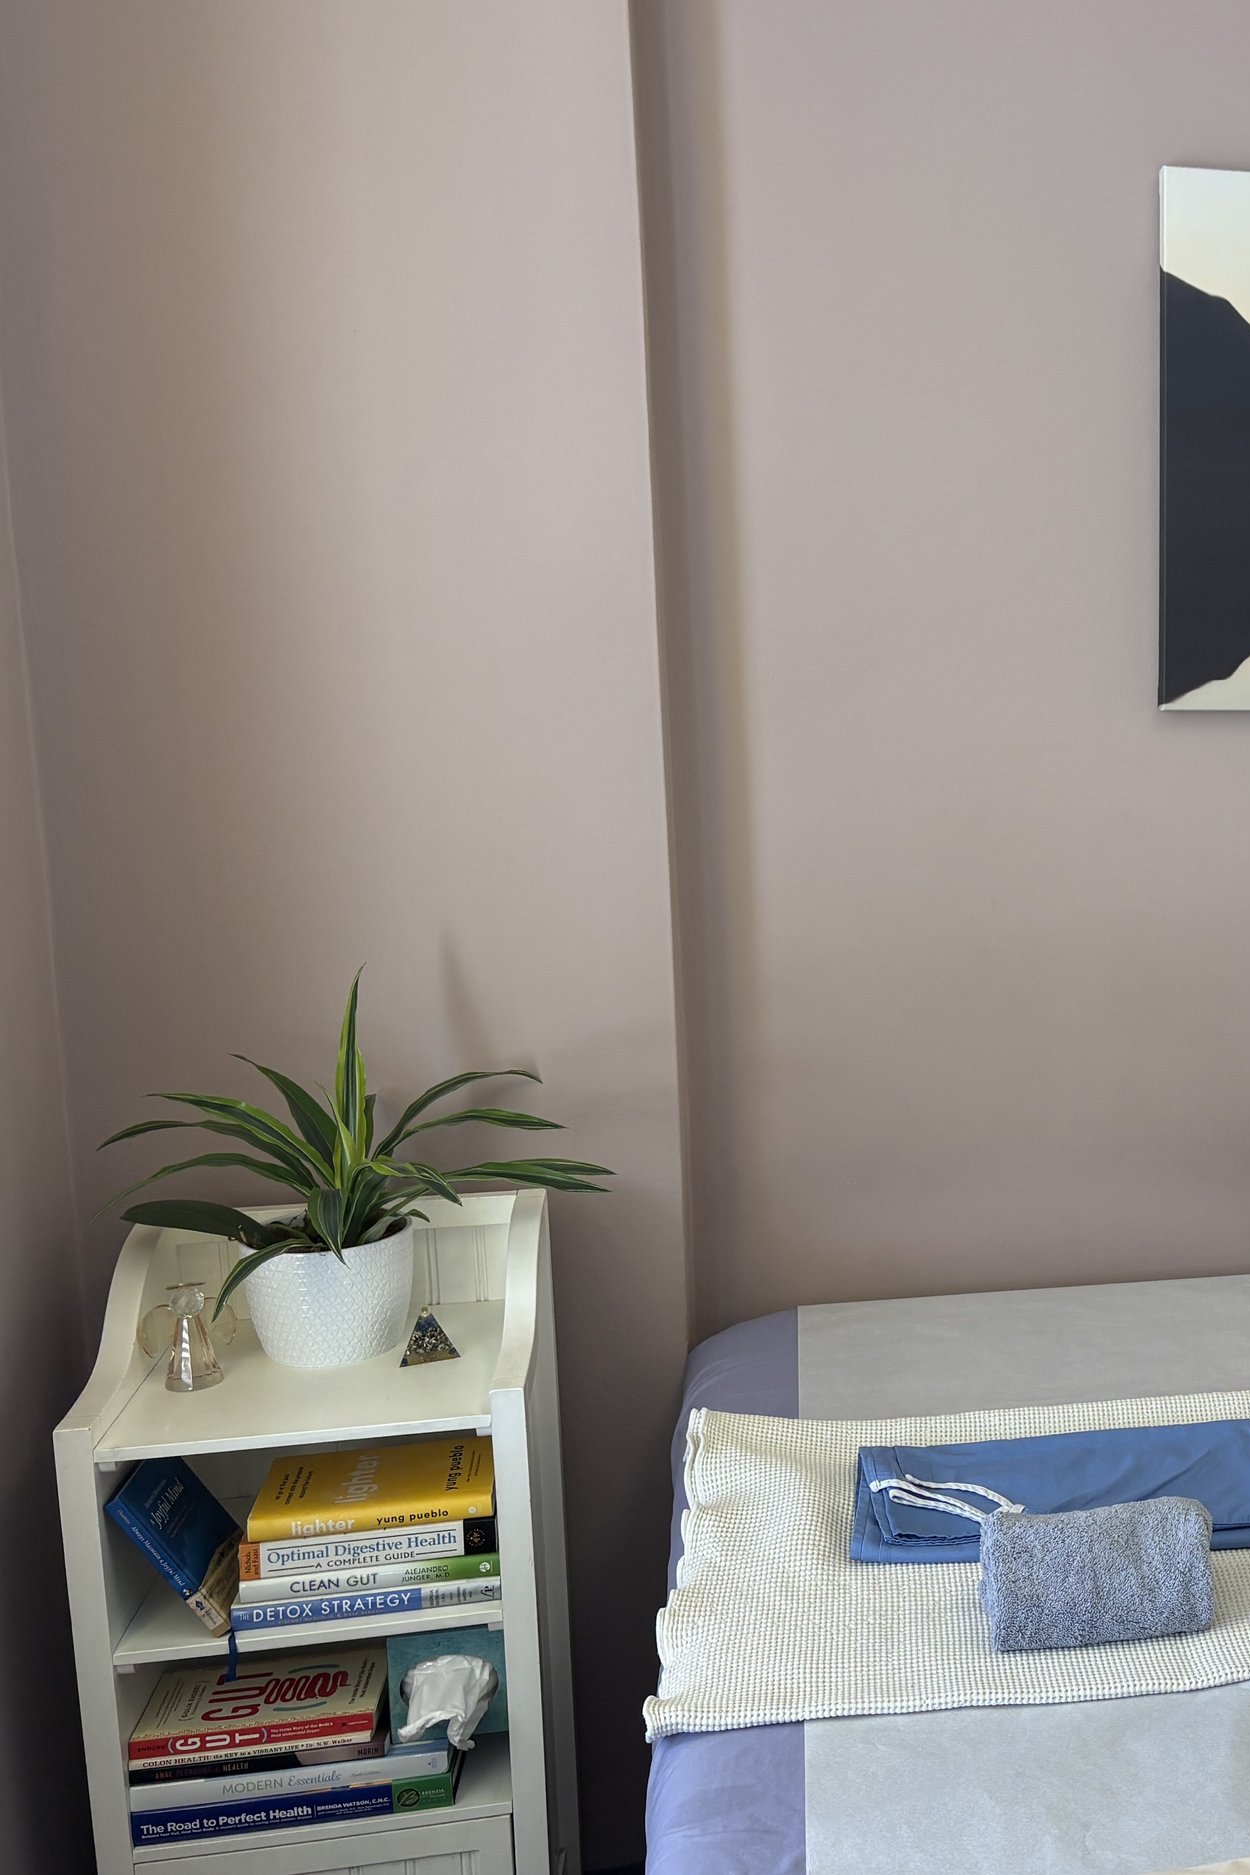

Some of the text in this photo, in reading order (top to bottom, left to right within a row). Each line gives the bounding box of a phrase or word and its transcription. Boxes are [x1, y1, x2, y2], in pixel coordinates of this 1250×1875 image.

[445, 1445, 464, 1491] yung pueblo
[335, 1455, 379, 1504] lighter
[376, 1509, 449, 1525] yung pueblo
[291, 1519, 355, 1536] lighter
[267, 1545, 329, 1566] Optimal
[334, 1539, 403, 1557] Digestive
[407, 1532, 457, 1549] Health
[327, 1555, 380, 1567] COMPLETE
[384, 1551, 416, 1561] GUIDE
[405, 1565, 449, 1575] ALEJANDRO
[290, 1573, 378, 1593] CLEAN GUT
[239, 1613, 250, 1621] THE
[253, 1603, 312, 1622] DETOX
[321, 1592, 411, 1614] STRATEGY
[142, 1759, 172, 1768] COLON
[174, 1755, 212, 1765] HEALTH:
[252, 1746, 283, 1755] VIBRANT
[357, 1747, 379, 1756] MORIN
[222, 1762, 249, 1772] HEALTH
[222, 1778, 283, 1795] MODERN
[288, 1770, 341, 1787] Essentials
[317, 1803, 342, 1811] BRENDA
[342, 1800, 372, 1808] WATSON,
[140, 1824, 165, 1835] The
[167, 1819, 200, 1832] Road
[203, 1818, 216, 1827] to
[218, 1811, 266, 1825] Perfect
[269, 1805, 312, 1819] Health
